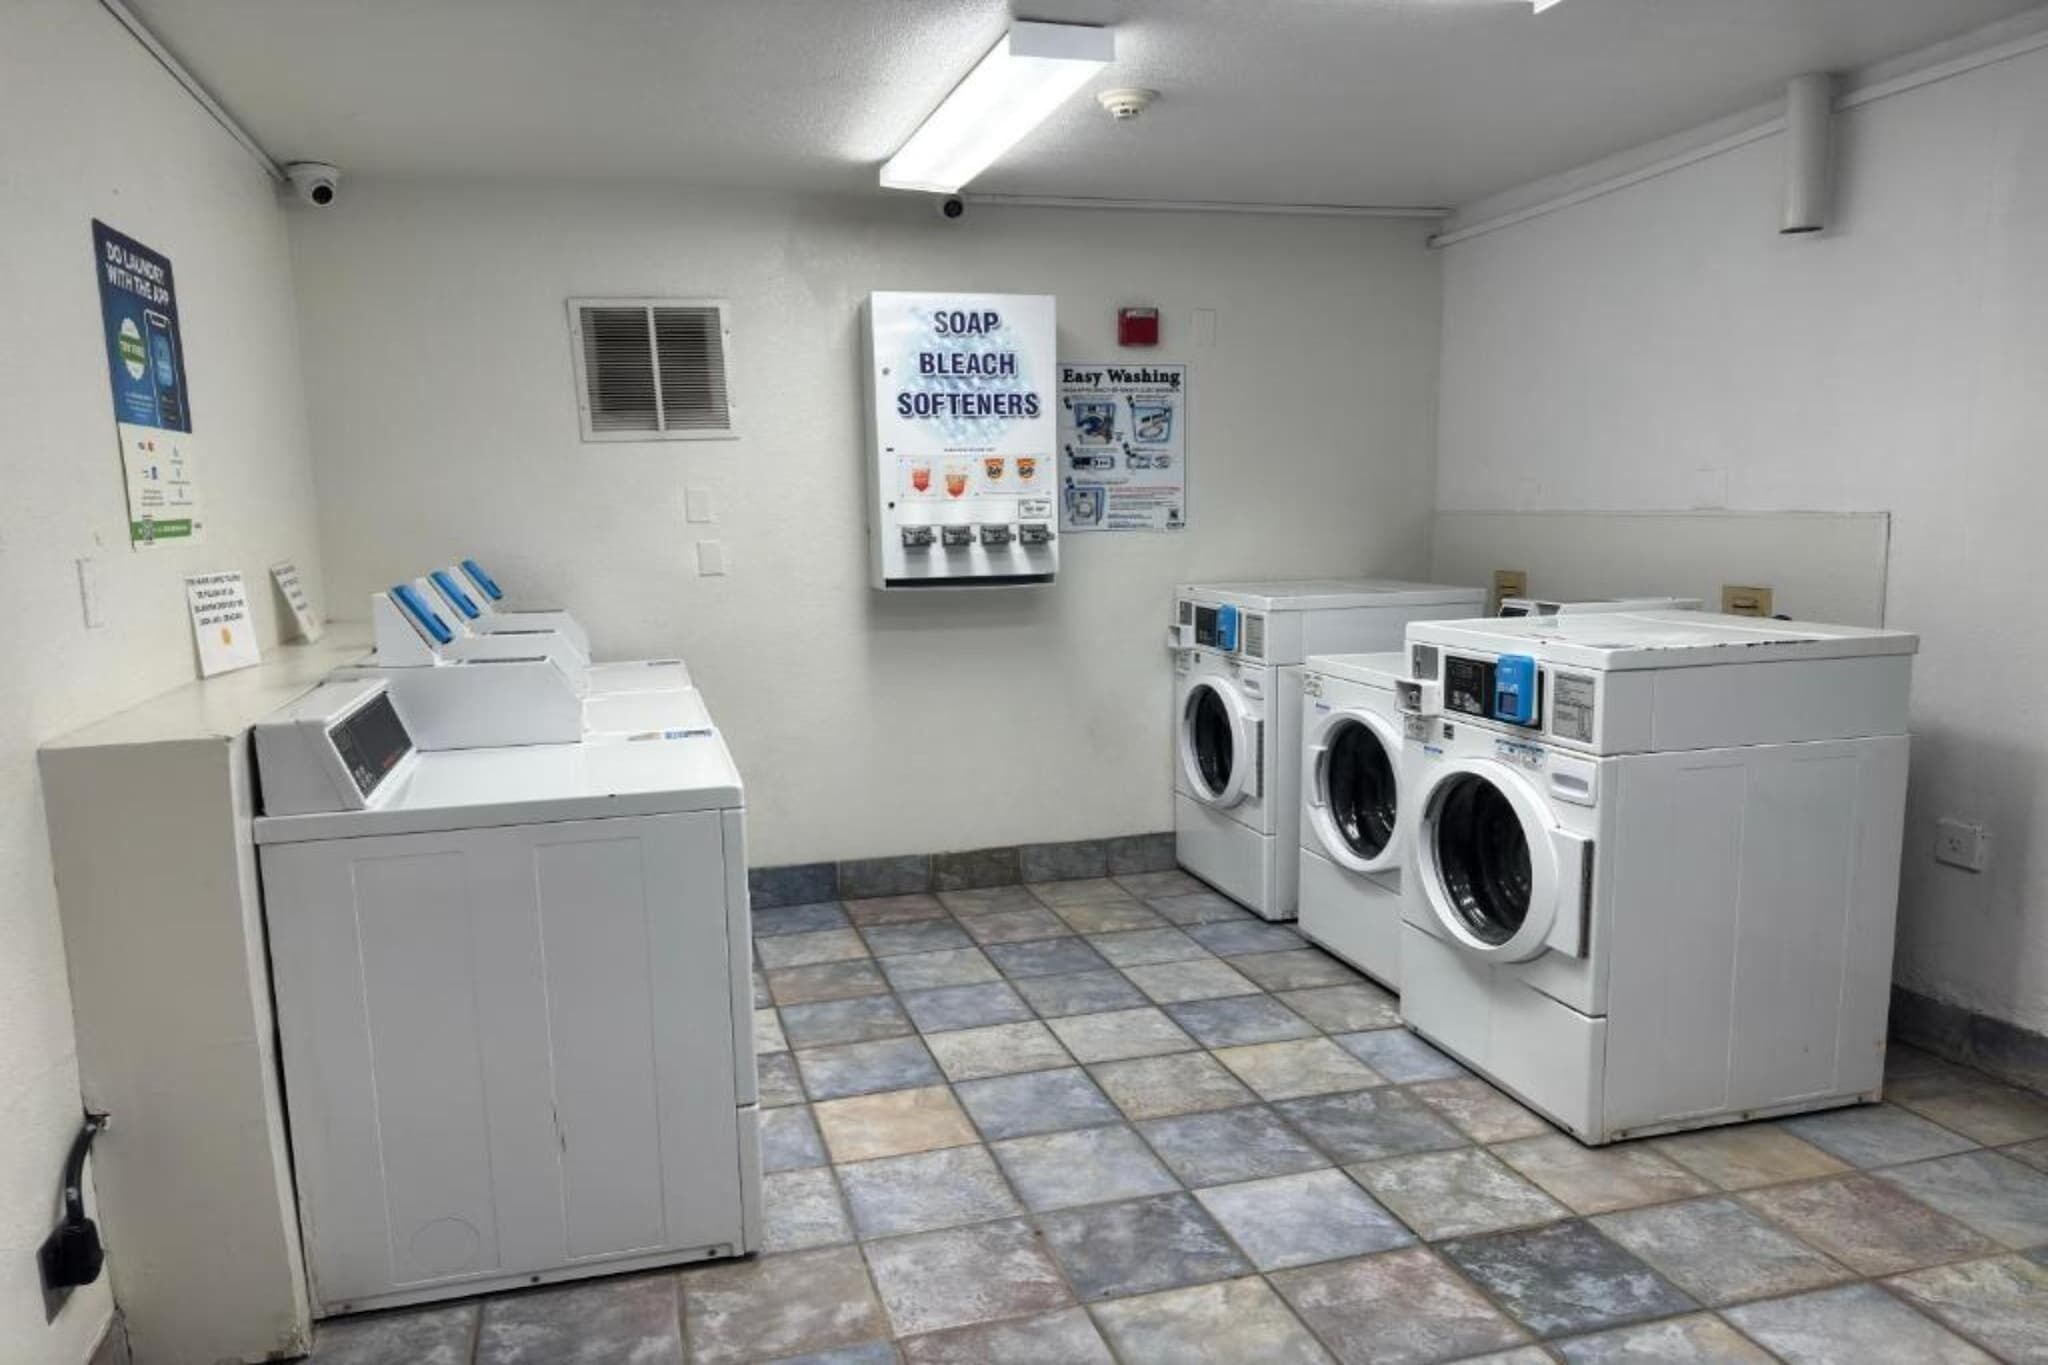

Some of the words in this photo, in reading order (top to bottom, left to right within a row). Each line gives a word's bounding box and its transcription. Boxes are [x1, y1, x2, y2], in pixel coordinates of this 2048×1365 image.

[106, 241, 122, 265] DO
[106, 263, 133, 292] WITH
[133, 276, 153, 300] THE
[934, 311, 1000, 334] SOAP
[919, 352, 1016, 376] BLEACH
[1062, 369, 1103, 387] Easy
[1107, 368, 1181, 388] Washing
[897, 393, 1039, 416] SOFTENERS
